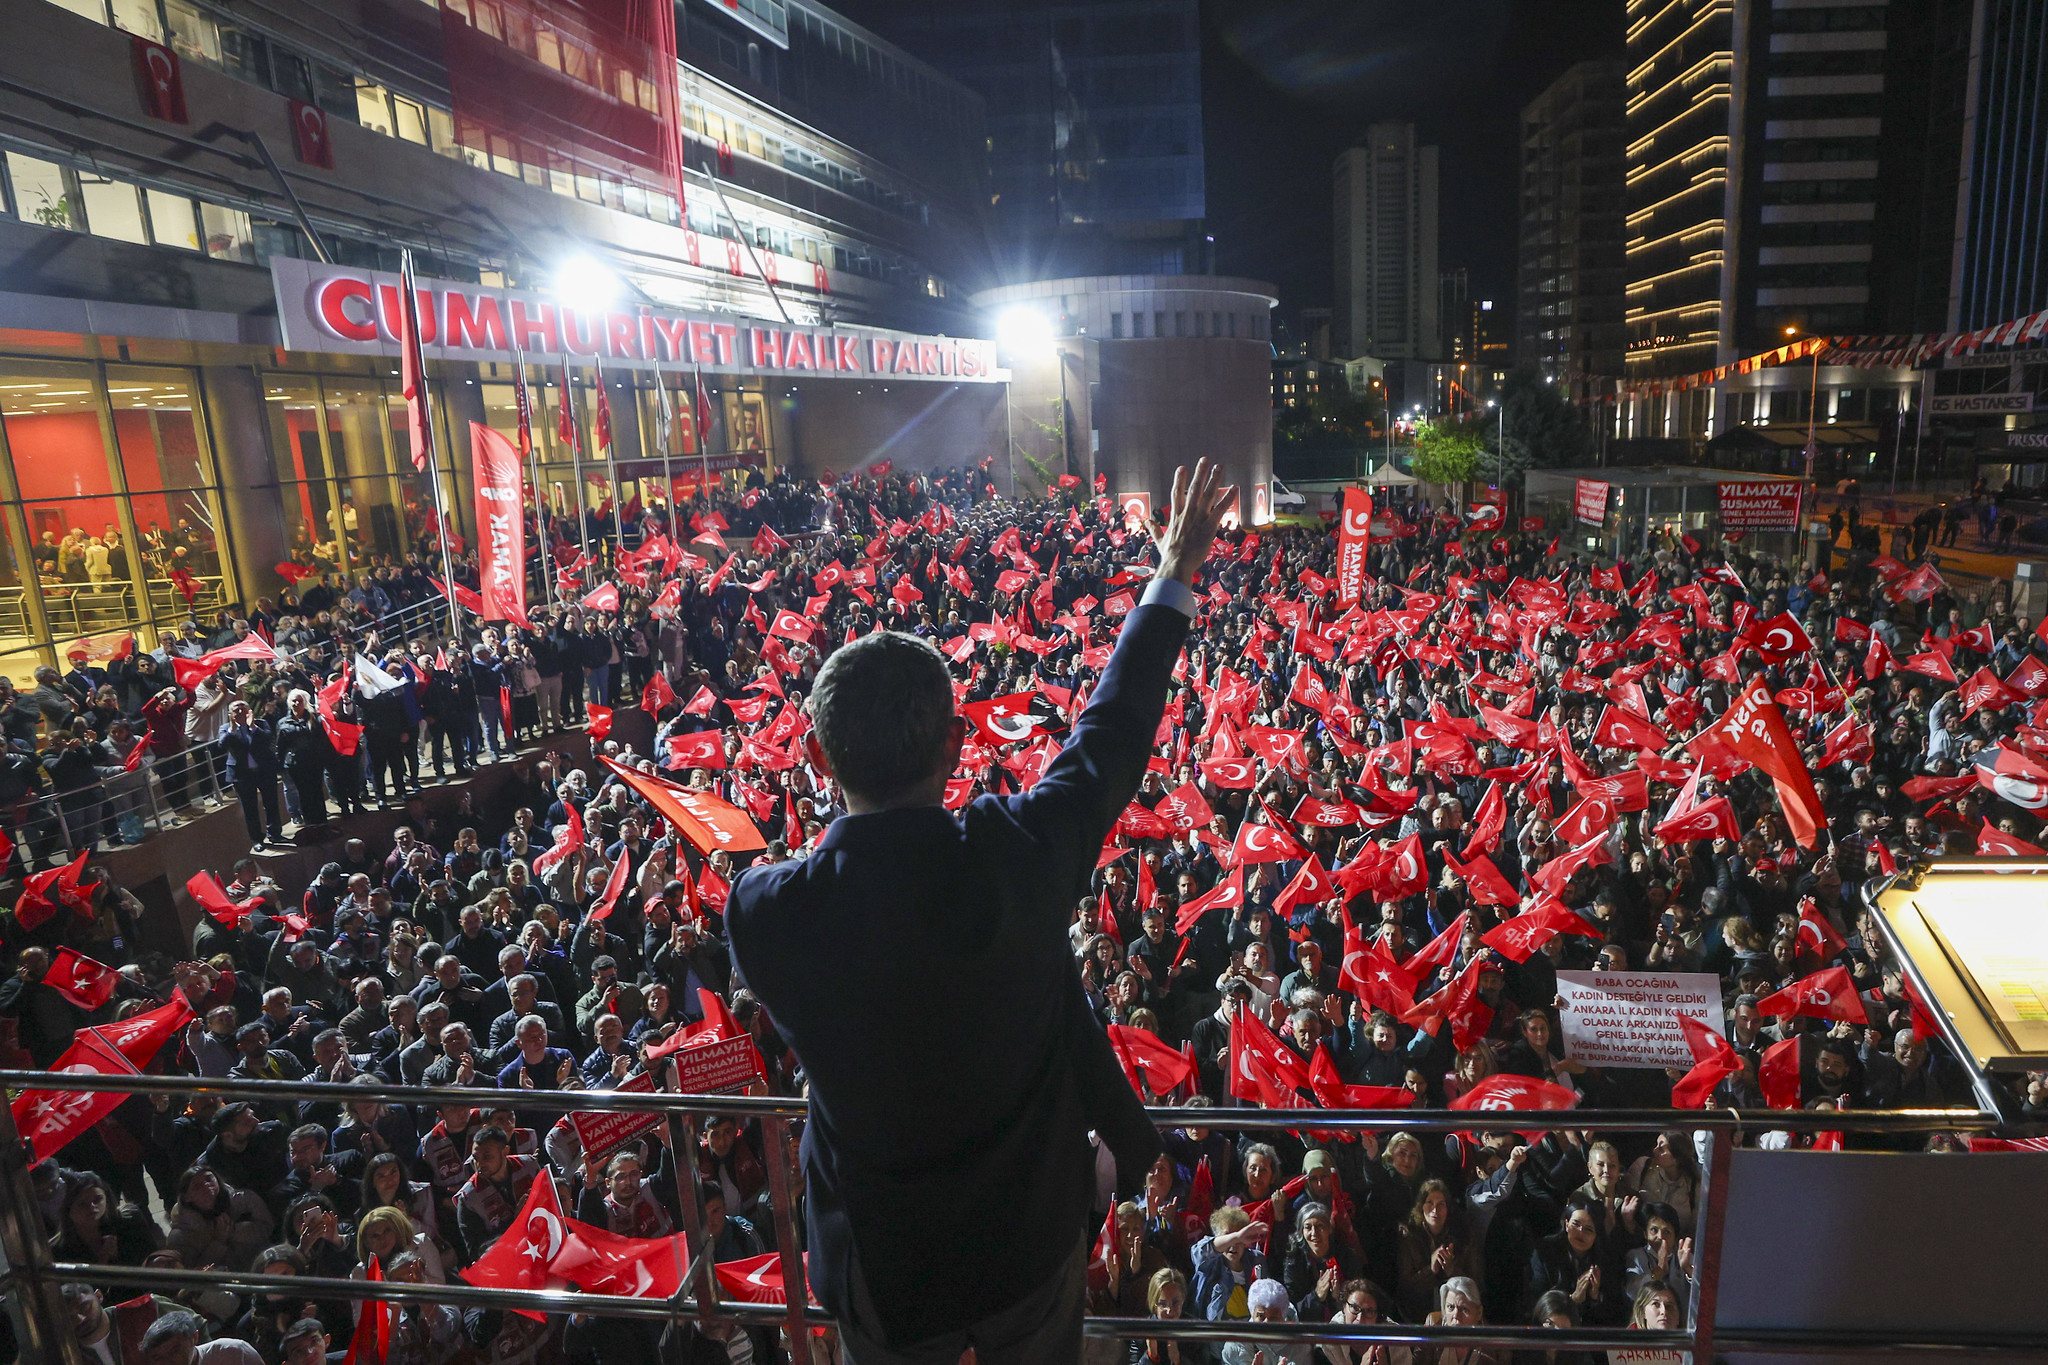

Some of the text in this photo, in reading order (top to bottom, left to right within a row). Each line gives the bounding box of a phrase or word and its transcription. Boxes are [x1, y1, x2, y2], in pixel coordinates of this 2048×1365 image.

[317, 278, 988, 377] CUMHURİYET HALK PARTİSİ
[1720, 484, 1798, 498] YILMAYIZ,
[1720, 500, 1782, 510] SUSMAYIZ,
[2023, 679, 2039, 691] CH
[1315, 812, 1344, 826] CHP
[1595, 977, 1680, 989] BABA OCAĞINA
[1572, 991, 1603, 1000] KADIN
[1606, 991, 1664, 1003] DESTEĞİYLE
[1573, 1005, 1615, 1015] ANKARA
[1618, 1004, 1627, 1015] İL
[1629, 1007, 1662, 1016] KADIN
[1582, 1018, 1684, 1030] OLARAK ARKANIZD
[1596, 1031, 1628, 1040] GENEL
[680, 1040, 751, 1066] YILMAYIZ,
[1614, 1045, 1654, 1055] HAKKINI
[1657, 1045, 1684, 1056] YİĞİT
[684, 1053, 750, 1077] SUSMAYIZ,
[683, 1063, 752, 1085] GENEL BAŞKANIMIZI
[684, 1069, 754, 1093] YALNIZ BIRAKMAYIZ
[585, 1111, 634, 1141] YANIND
[589, 1133, 616, 1152] GENEL
